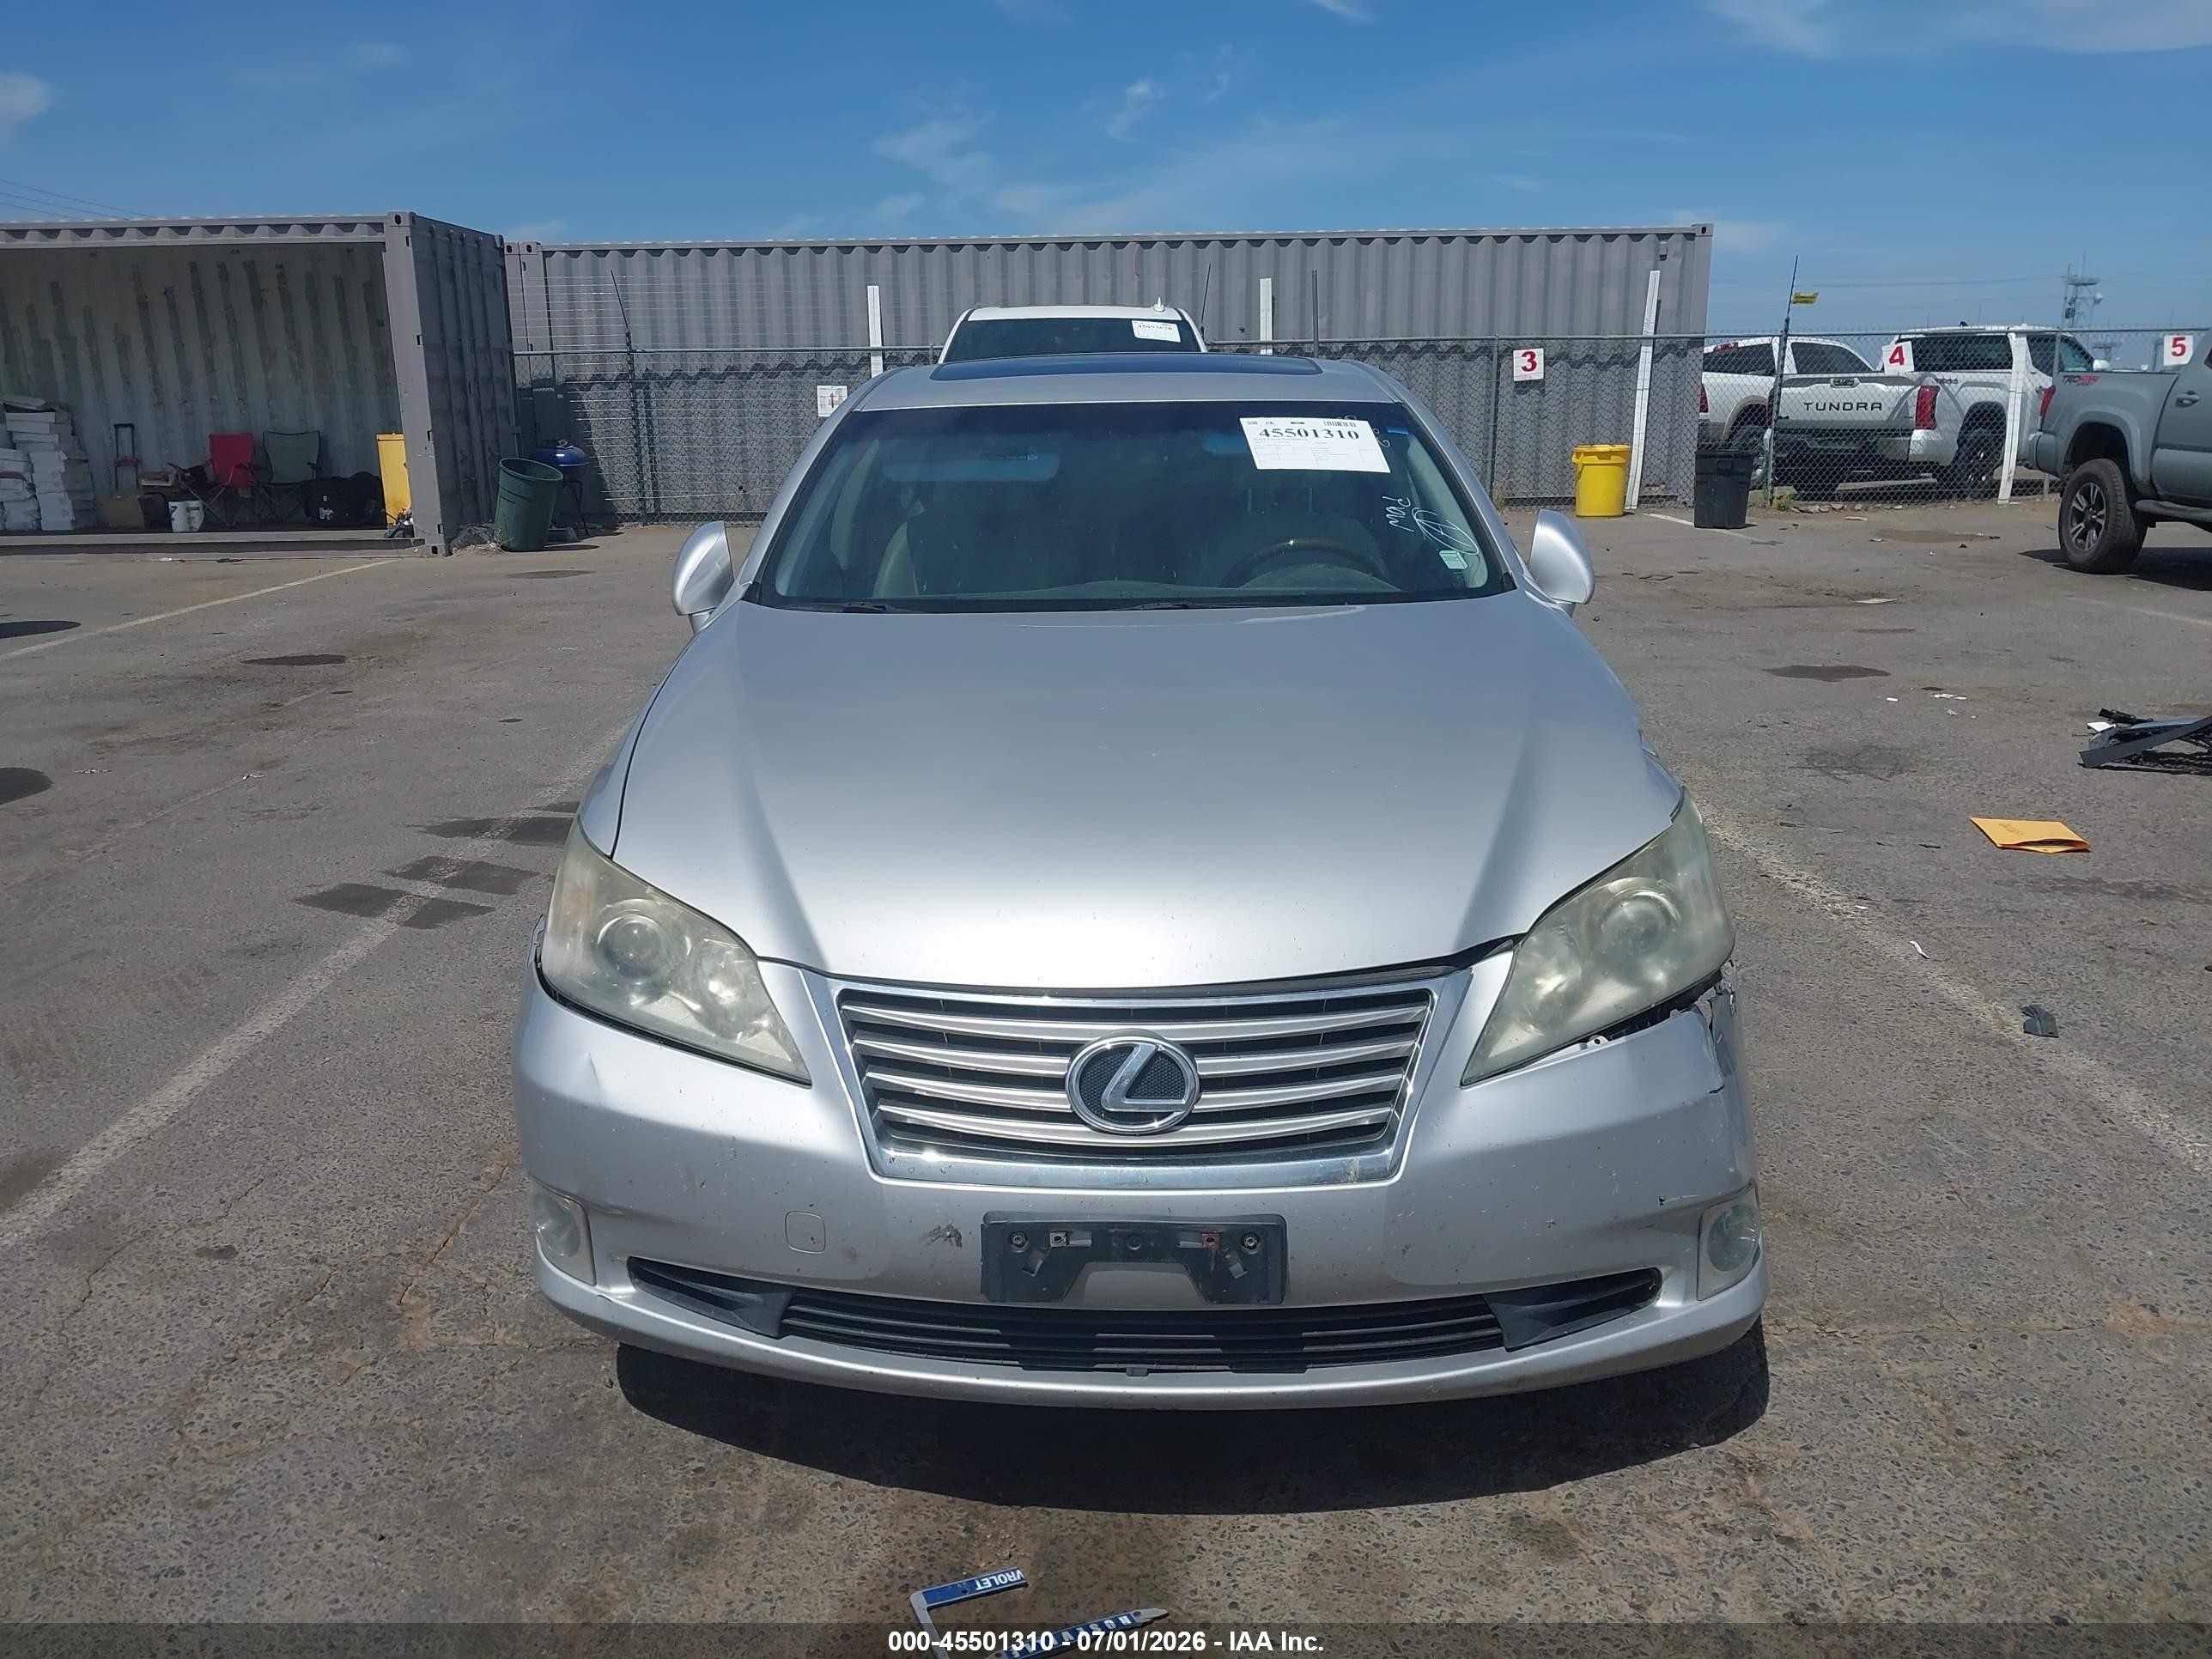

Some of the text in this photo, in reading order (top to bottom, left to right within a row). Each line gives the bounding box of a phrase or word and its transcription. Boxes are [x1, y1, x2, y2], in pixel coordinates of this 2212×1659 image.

[1888, 346, 1906, 365] 4
[2170, 337, 2186, 357] 5
[1521, 350, 1538, 372] 3
[1803, 402, 1883, 411] TUNDRA
[1259, 428, 1360, 441] 45501310
[975, 1569, 1025, 1591] VROLET
